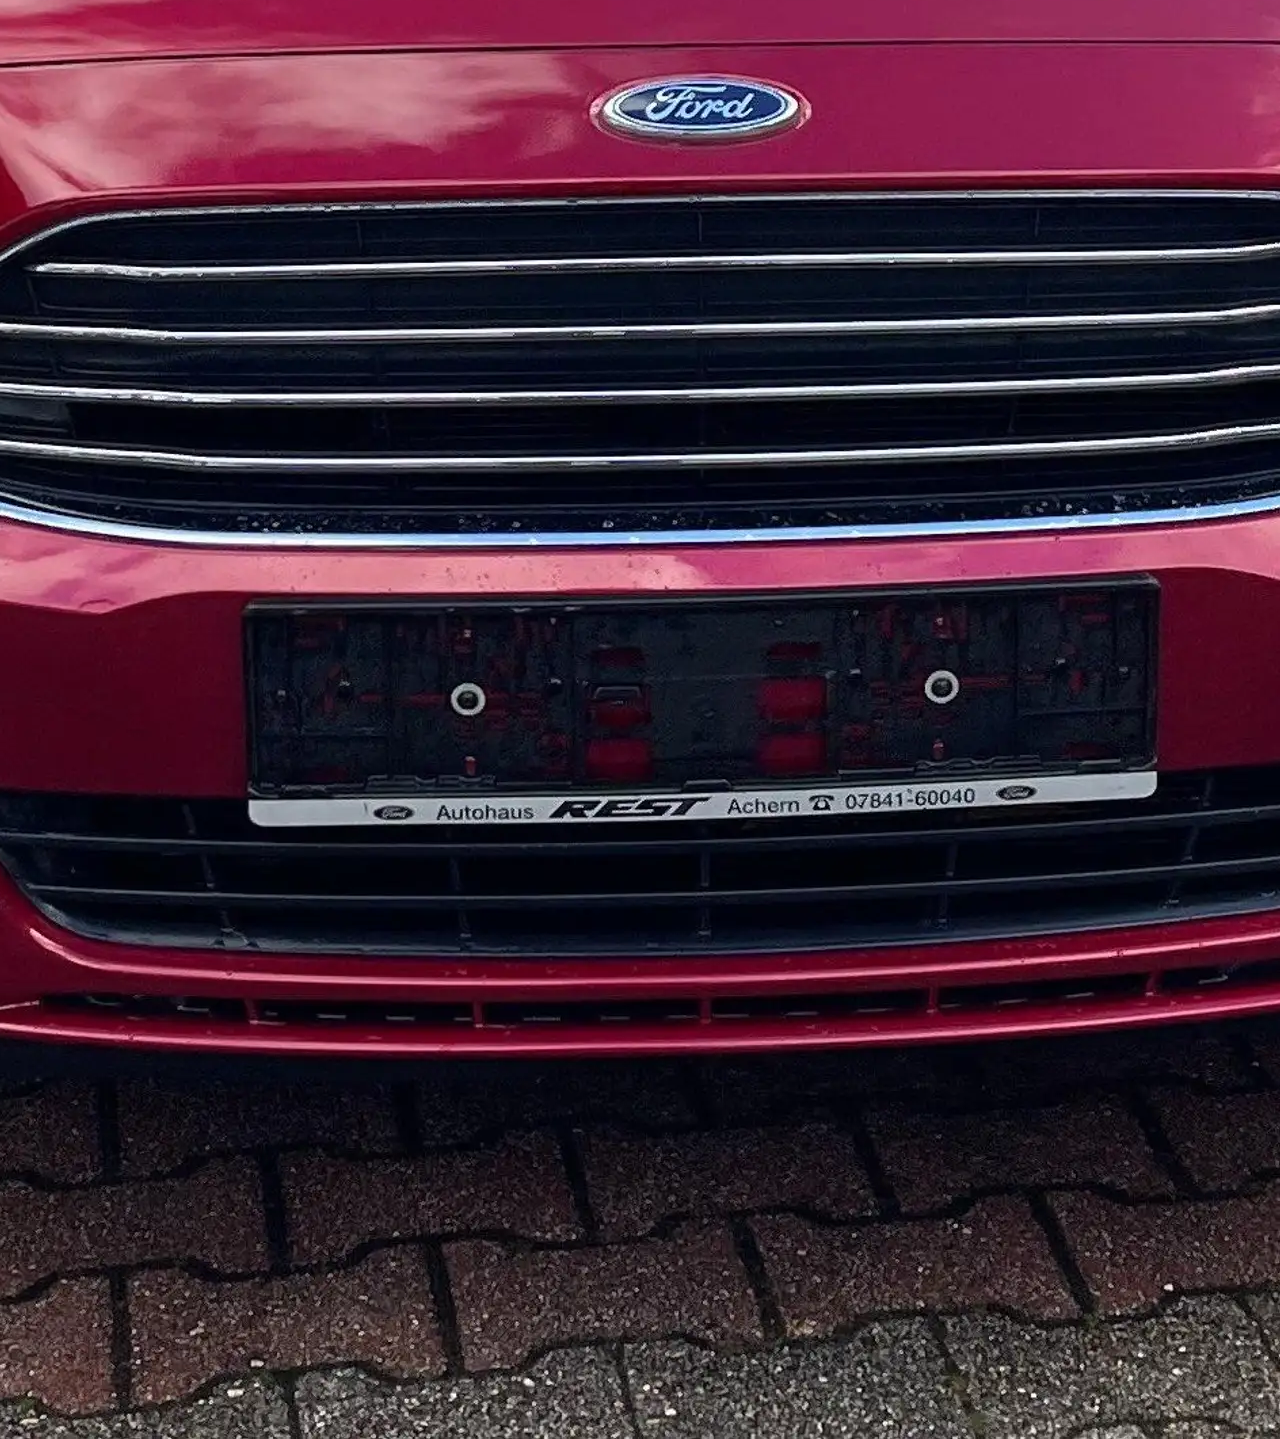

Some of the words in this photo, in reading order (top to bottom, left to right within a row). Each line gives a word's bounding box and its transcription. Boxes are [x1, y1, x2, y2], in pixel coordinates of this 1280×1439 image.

[645, 84, 755, 121] Ford
[436, 803, 535, 822] Autohaus
[548, 797, 710, 820] REST
[727, 797, 800, 816] Achern
[845, 788, 976, 810] 07841-60040
